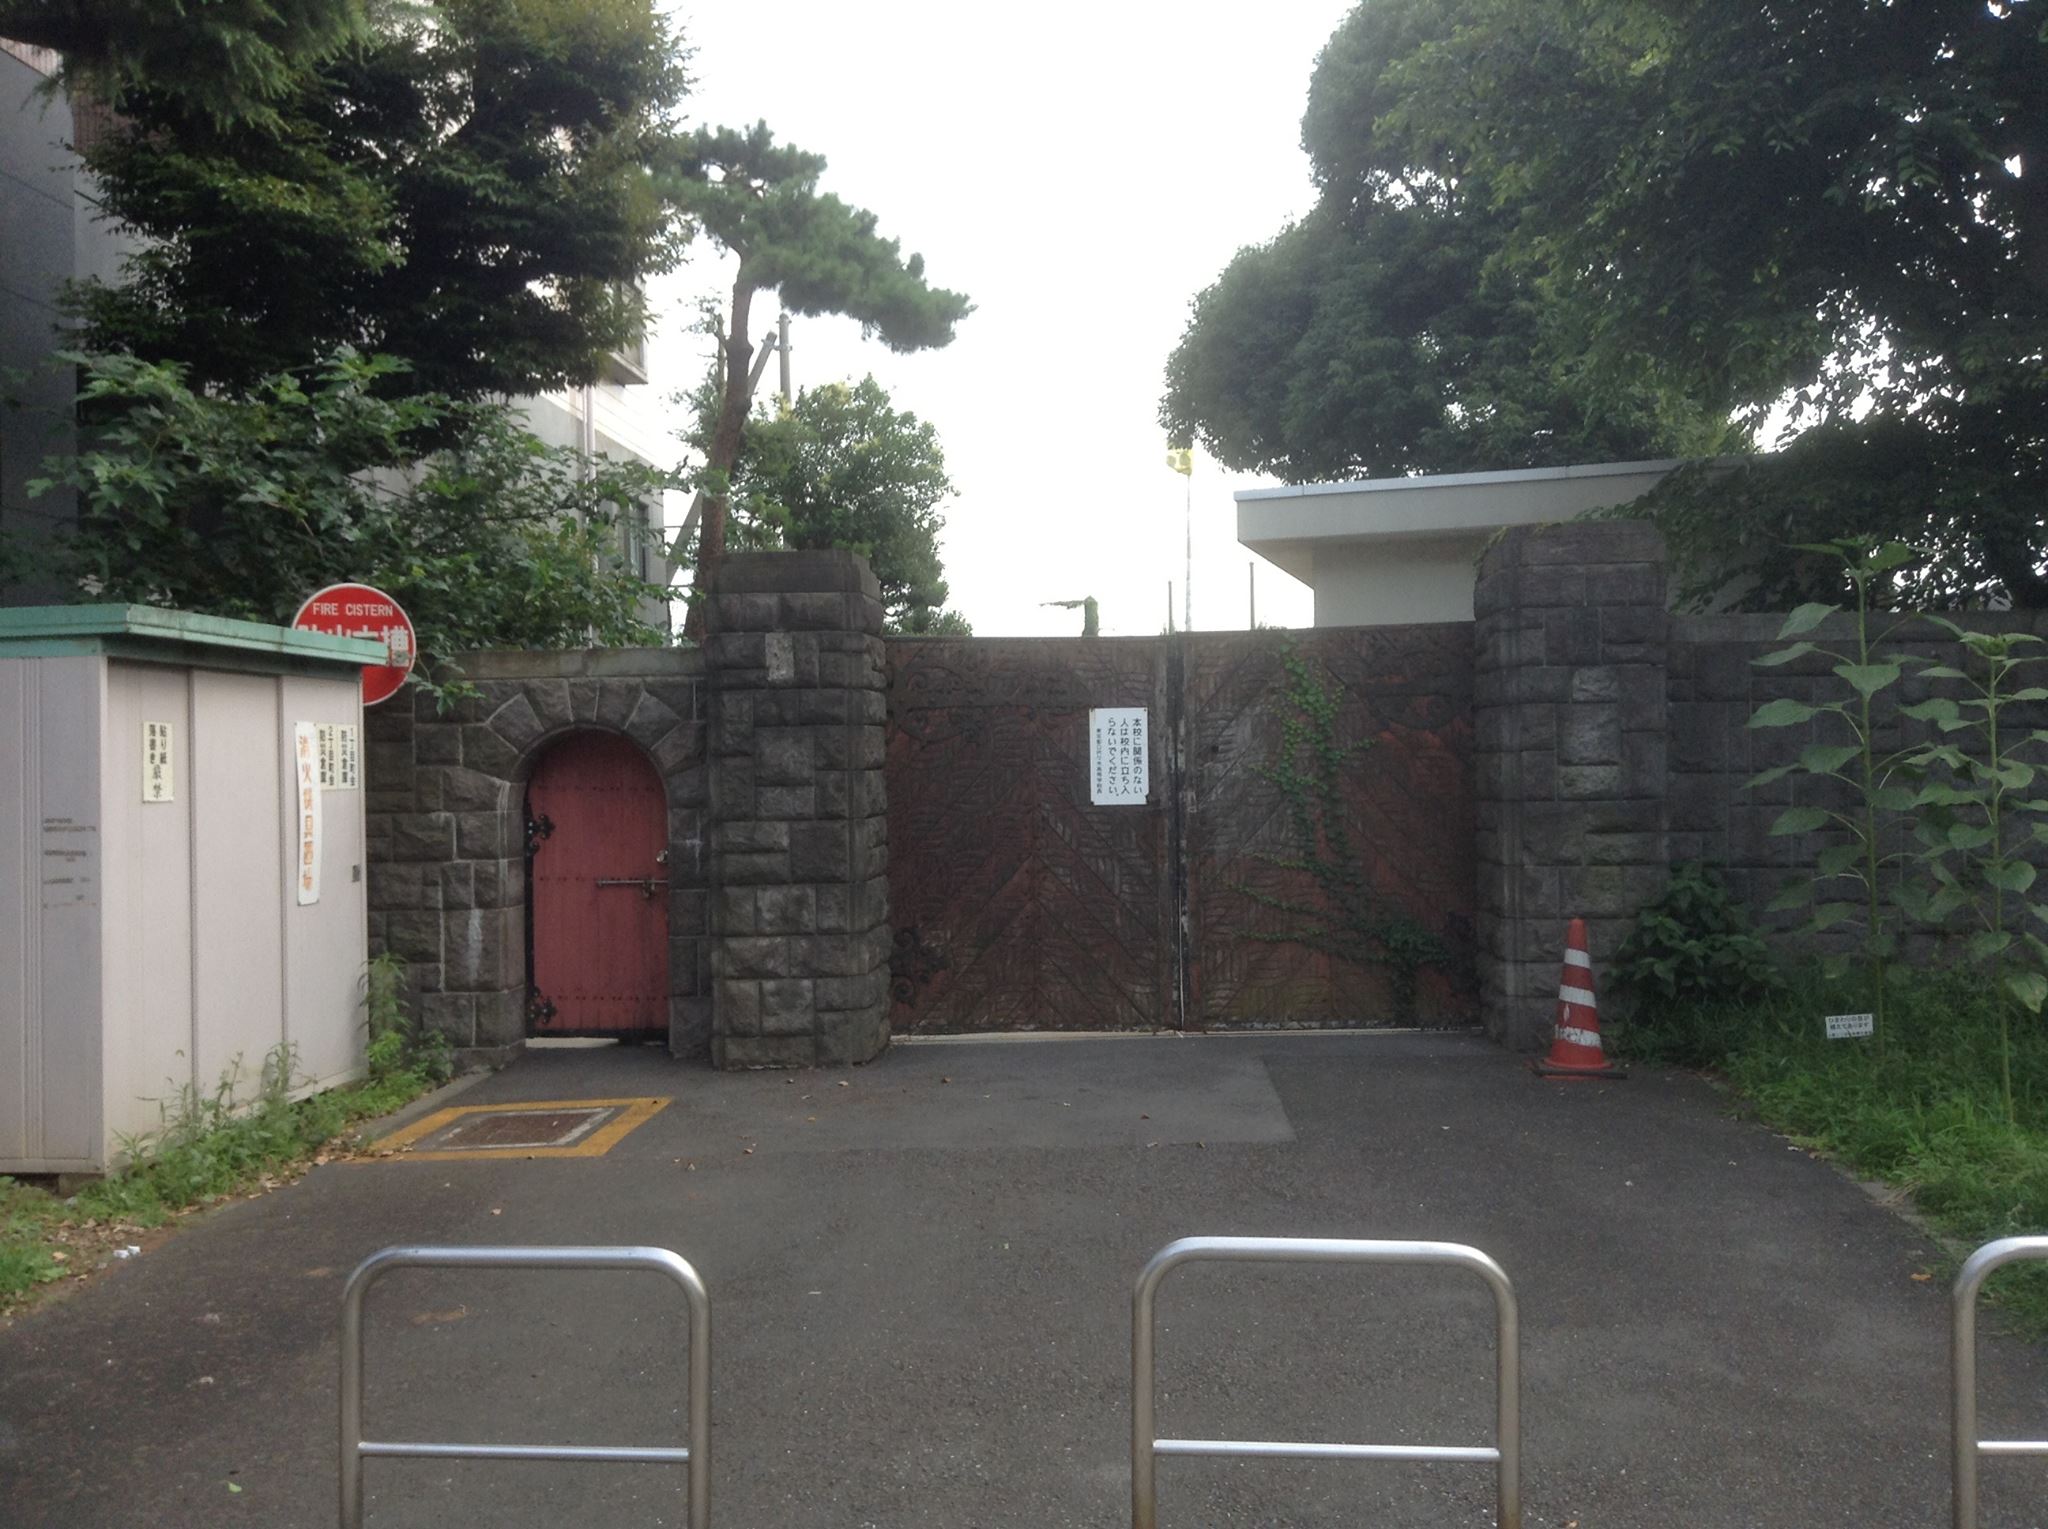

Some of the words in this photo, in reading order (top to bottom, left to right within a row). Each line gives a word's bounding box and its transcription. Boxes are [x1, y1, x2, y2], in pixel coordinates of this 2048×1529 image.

[312, 602, 339, 616] FIRE
[345, 603, 393, 616] CISTERN
[159, 724, 167, 765] 貼り紙
[1120, 718, 1130, 795] 人は校内に立ち入
[1132, 718, 1143, 794] 本校に関係のない
